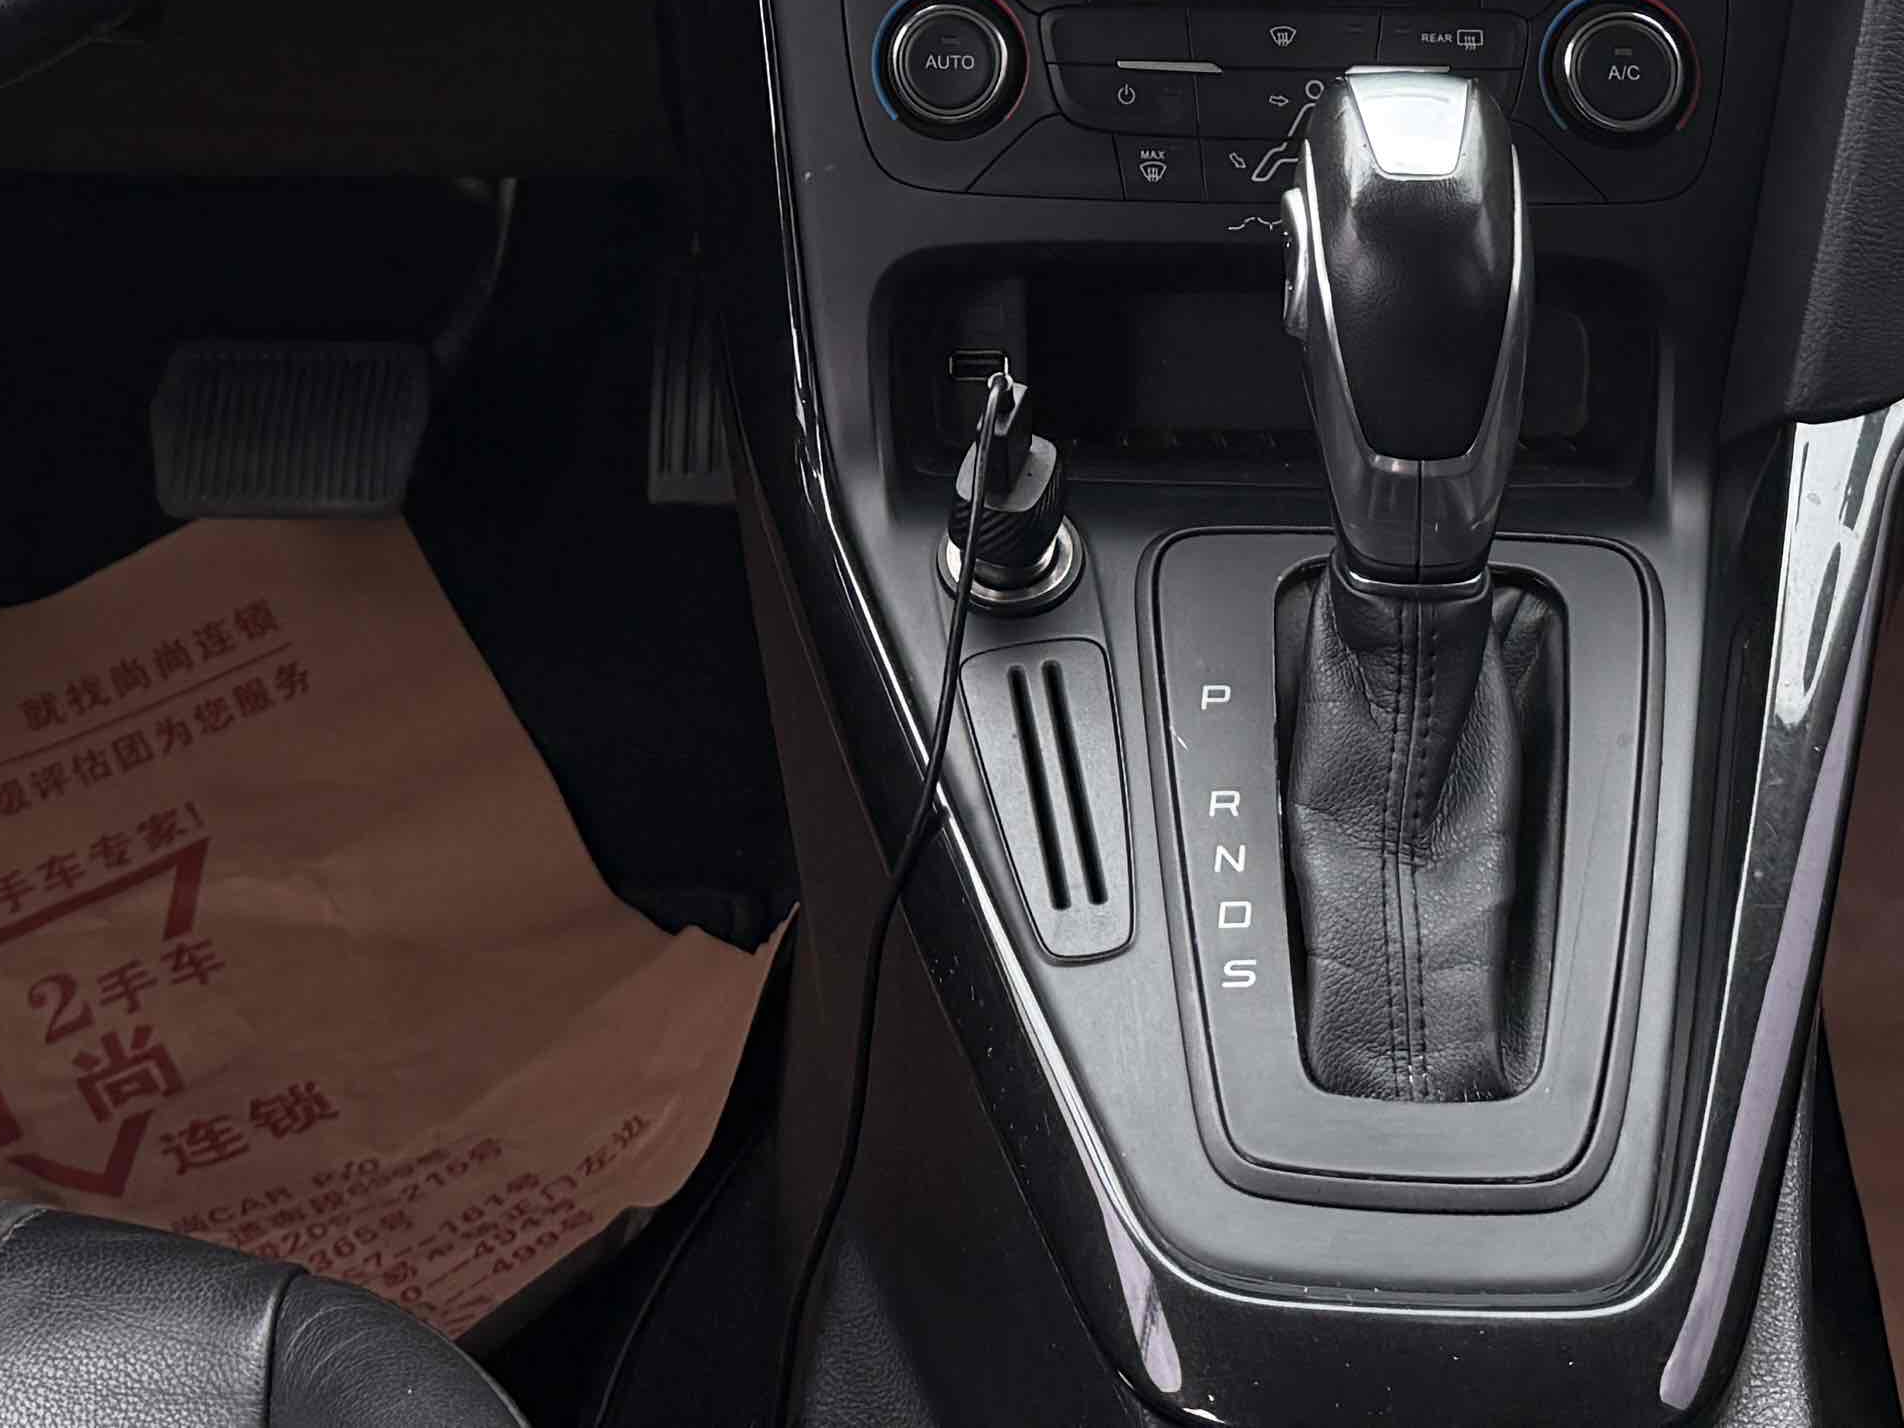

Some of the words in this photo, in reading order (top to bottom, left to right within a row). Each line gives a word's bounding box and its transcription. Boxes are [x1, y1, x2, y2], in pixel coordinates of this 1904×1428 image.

[1421, 33, 1453, 43] REAR
[924, 54, 975, 70] AUTO
[1607, 65, 1641, 81] A/C
[1140, 150, 1167, 160] MAX
[1200, 684, 1231, 710] P
[1209, 790, 1241, 817] R
[1214, 844, 1246, 873] N
[1218, 900, 1252, 929] D
[1221, 959, 1257, 988] S
[159, 1079, 340, 1178] 连锁
